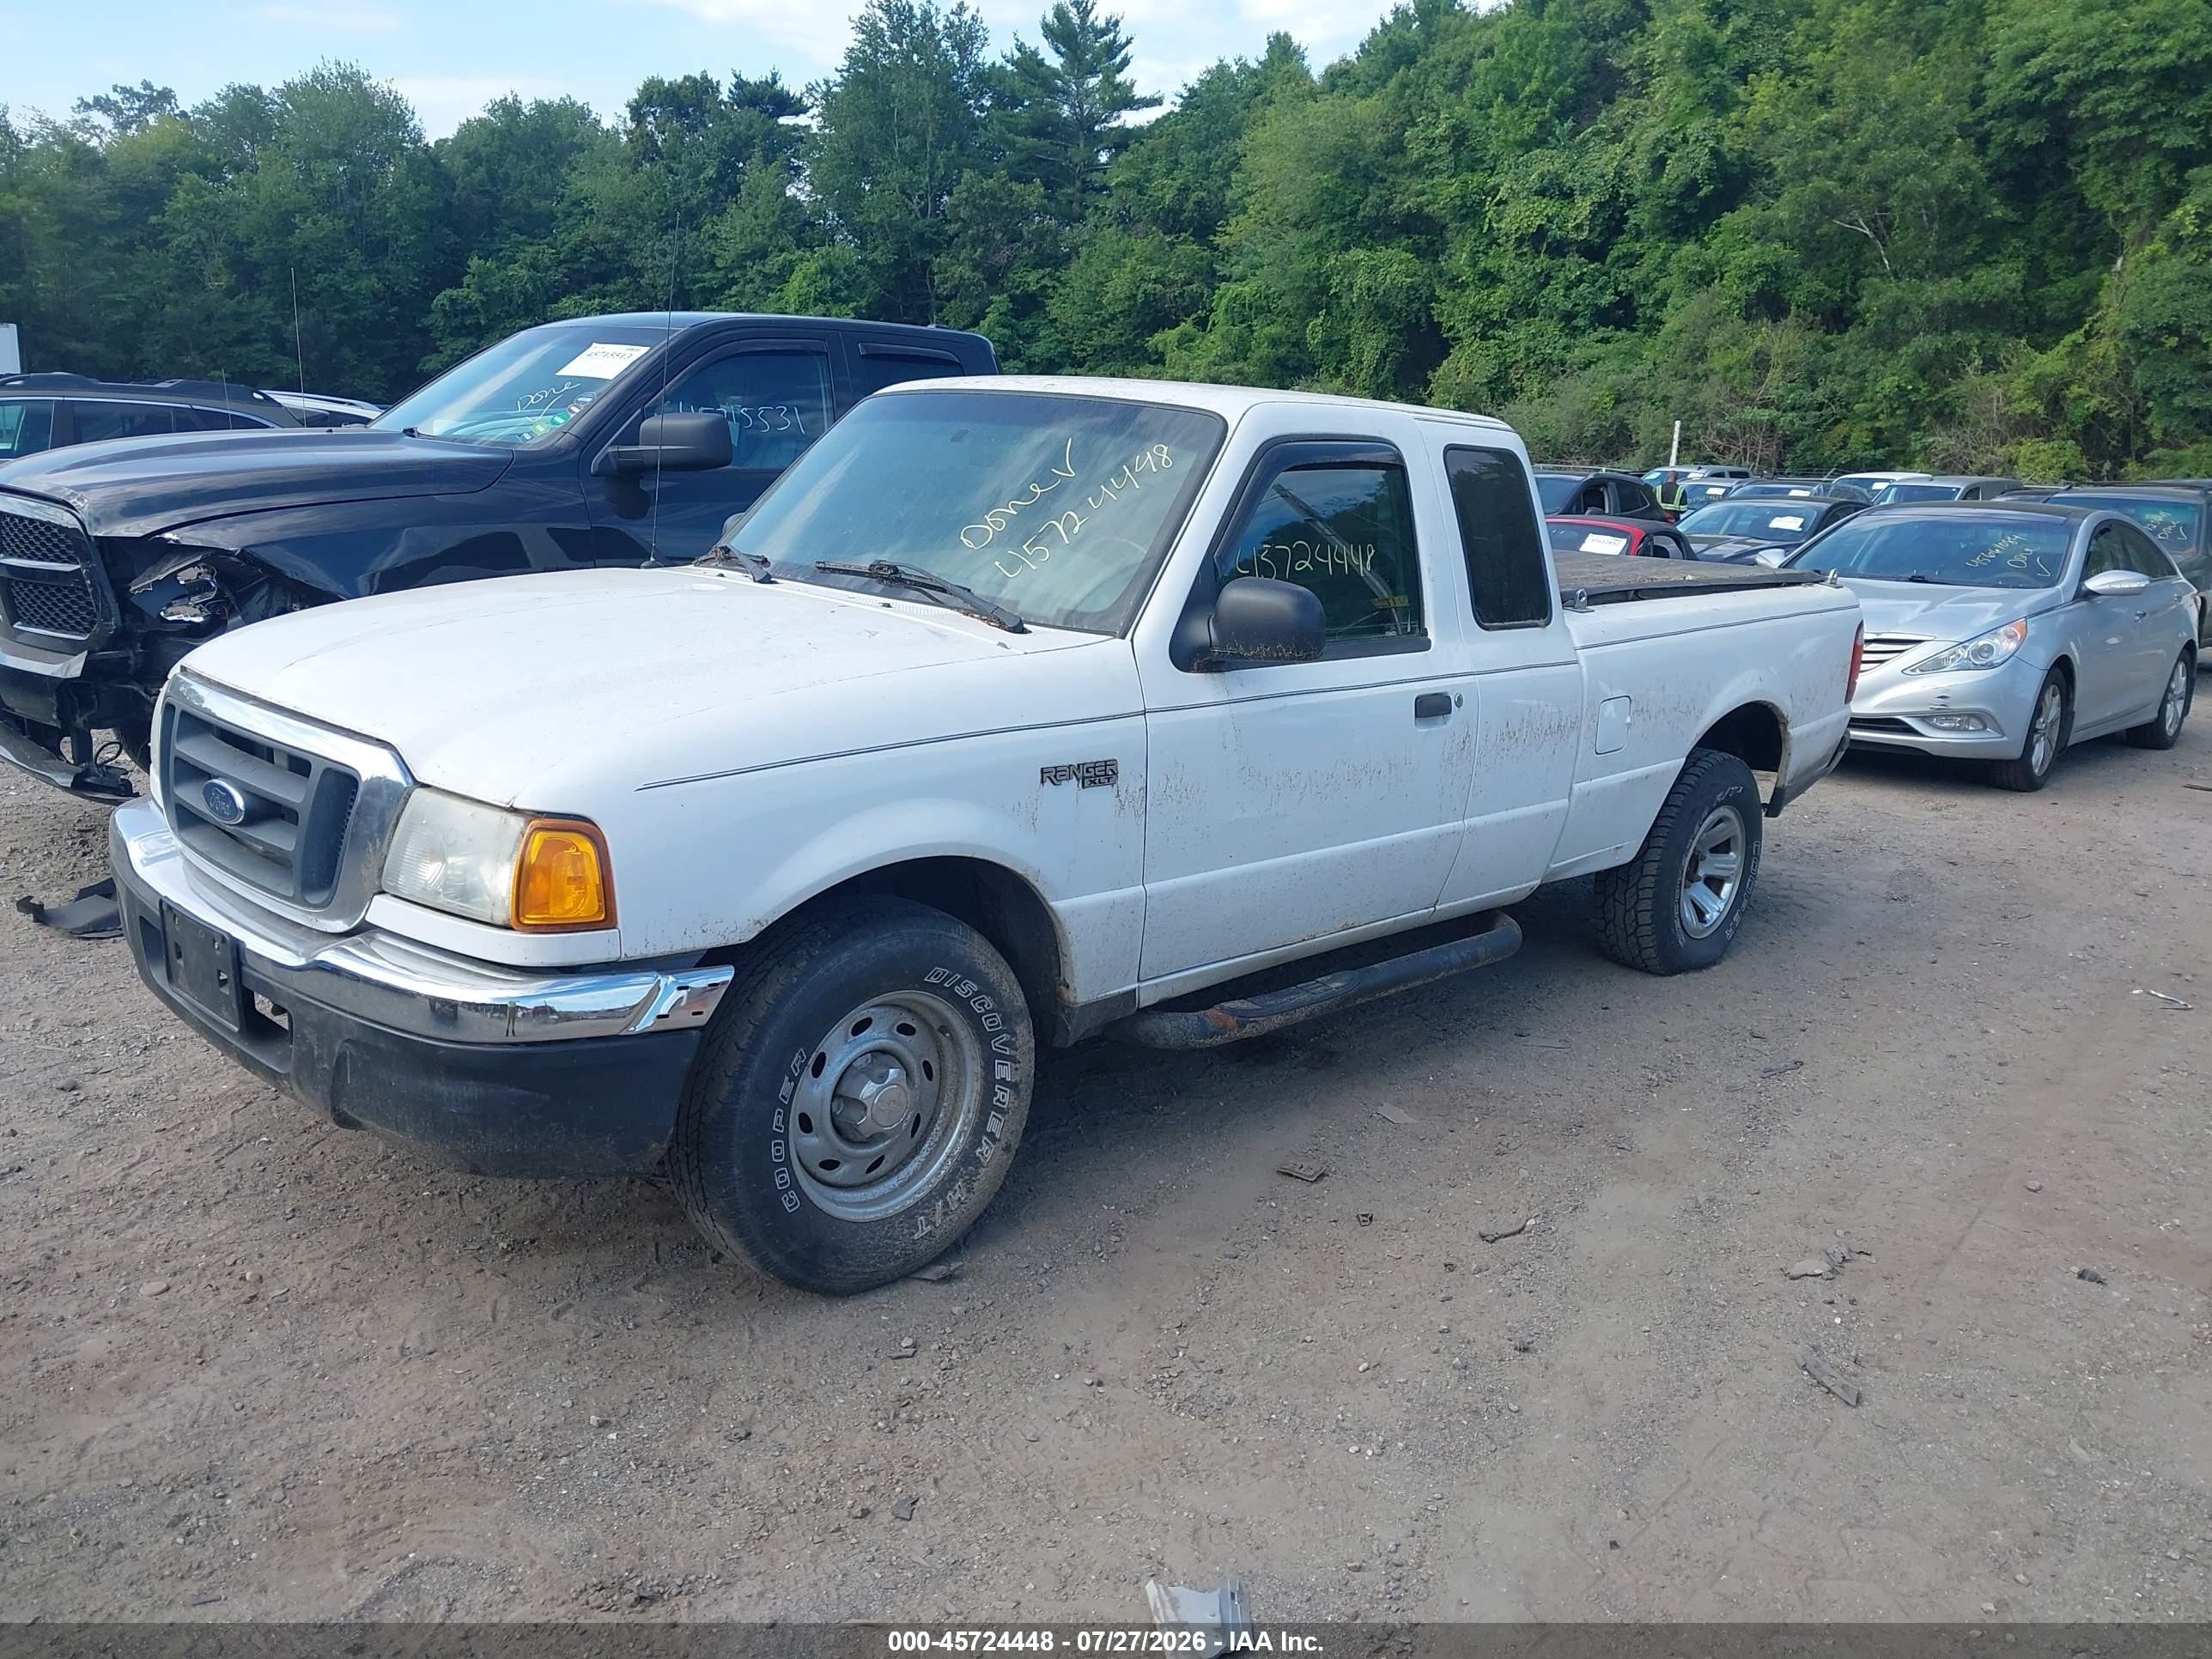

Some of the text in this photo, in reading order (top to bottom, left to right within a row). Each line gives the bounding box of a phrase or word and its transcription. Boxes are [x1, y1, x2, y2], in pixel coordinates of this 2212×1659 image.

[518, 381, 580, 412] Done
[960, 478, 1060, 550] Done
[1236, 540, 1376, 580] 45724448
[1040, 758, 1118, 786] RANGER
[1087, 776, 1115, 787] XLT
[924, 966, 1013, 1164] DISCOVERER
[772, 1048, 806, 1213] COOPER
